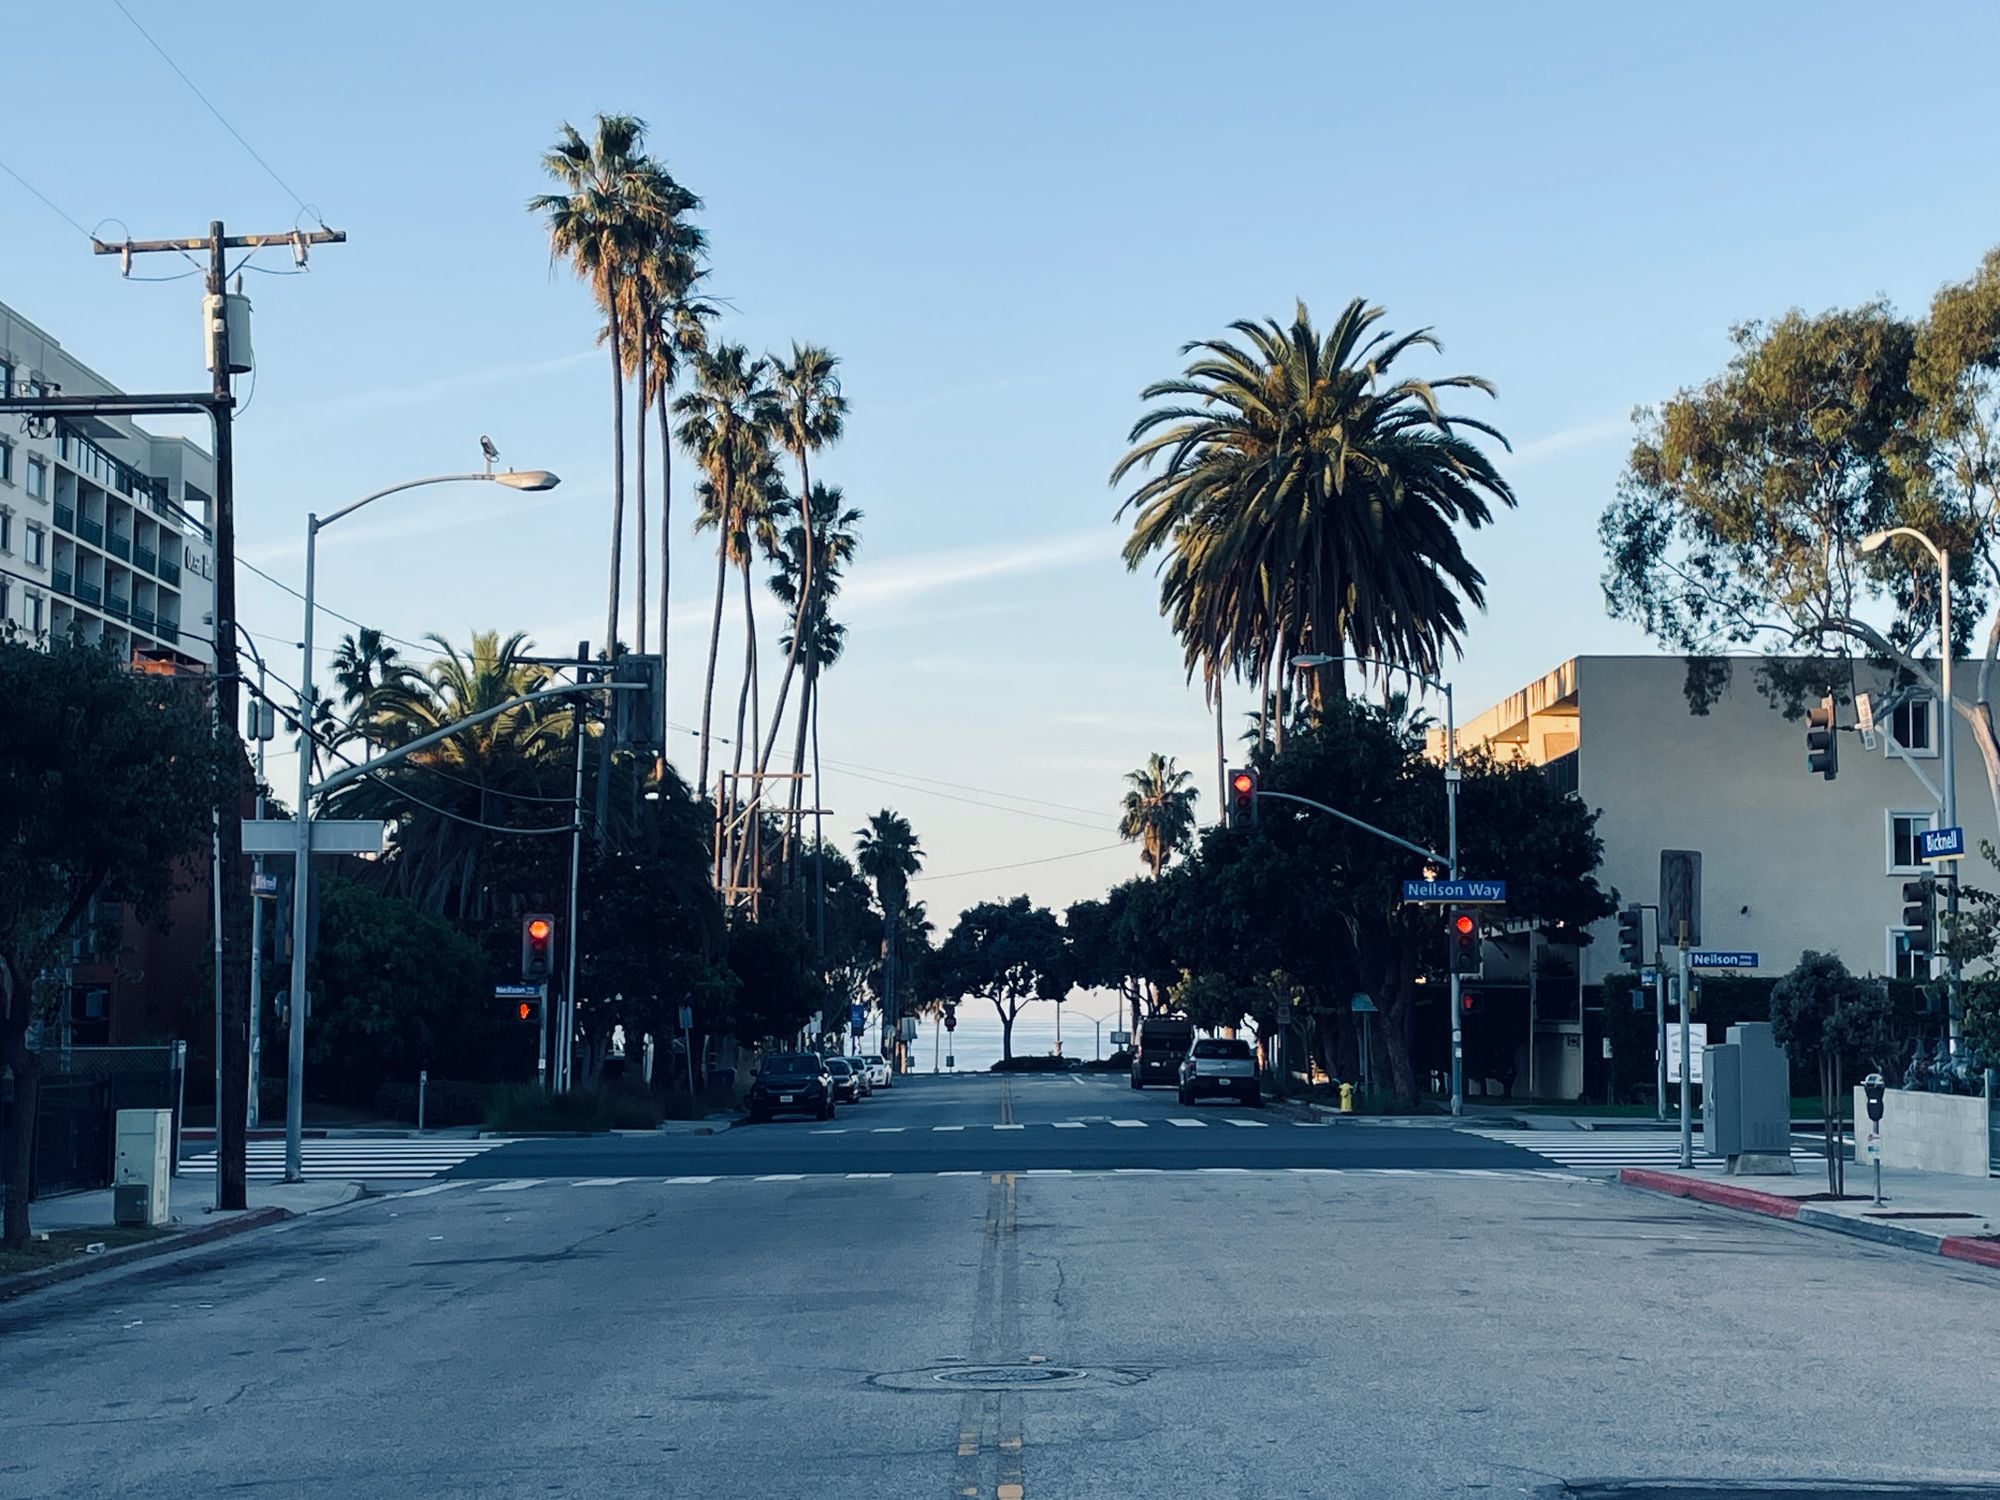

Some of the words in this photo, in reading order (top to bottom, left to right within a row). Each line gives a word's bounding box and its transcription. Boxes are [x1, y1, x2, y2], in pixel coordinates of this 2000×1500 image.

[1926, 830, 1958, 852] Bicknell
[1408, 883, 1463, 896] Neilson
[1468, 883, 1501, 900] Way
[1694, 953, 1738, 965] Neilson
